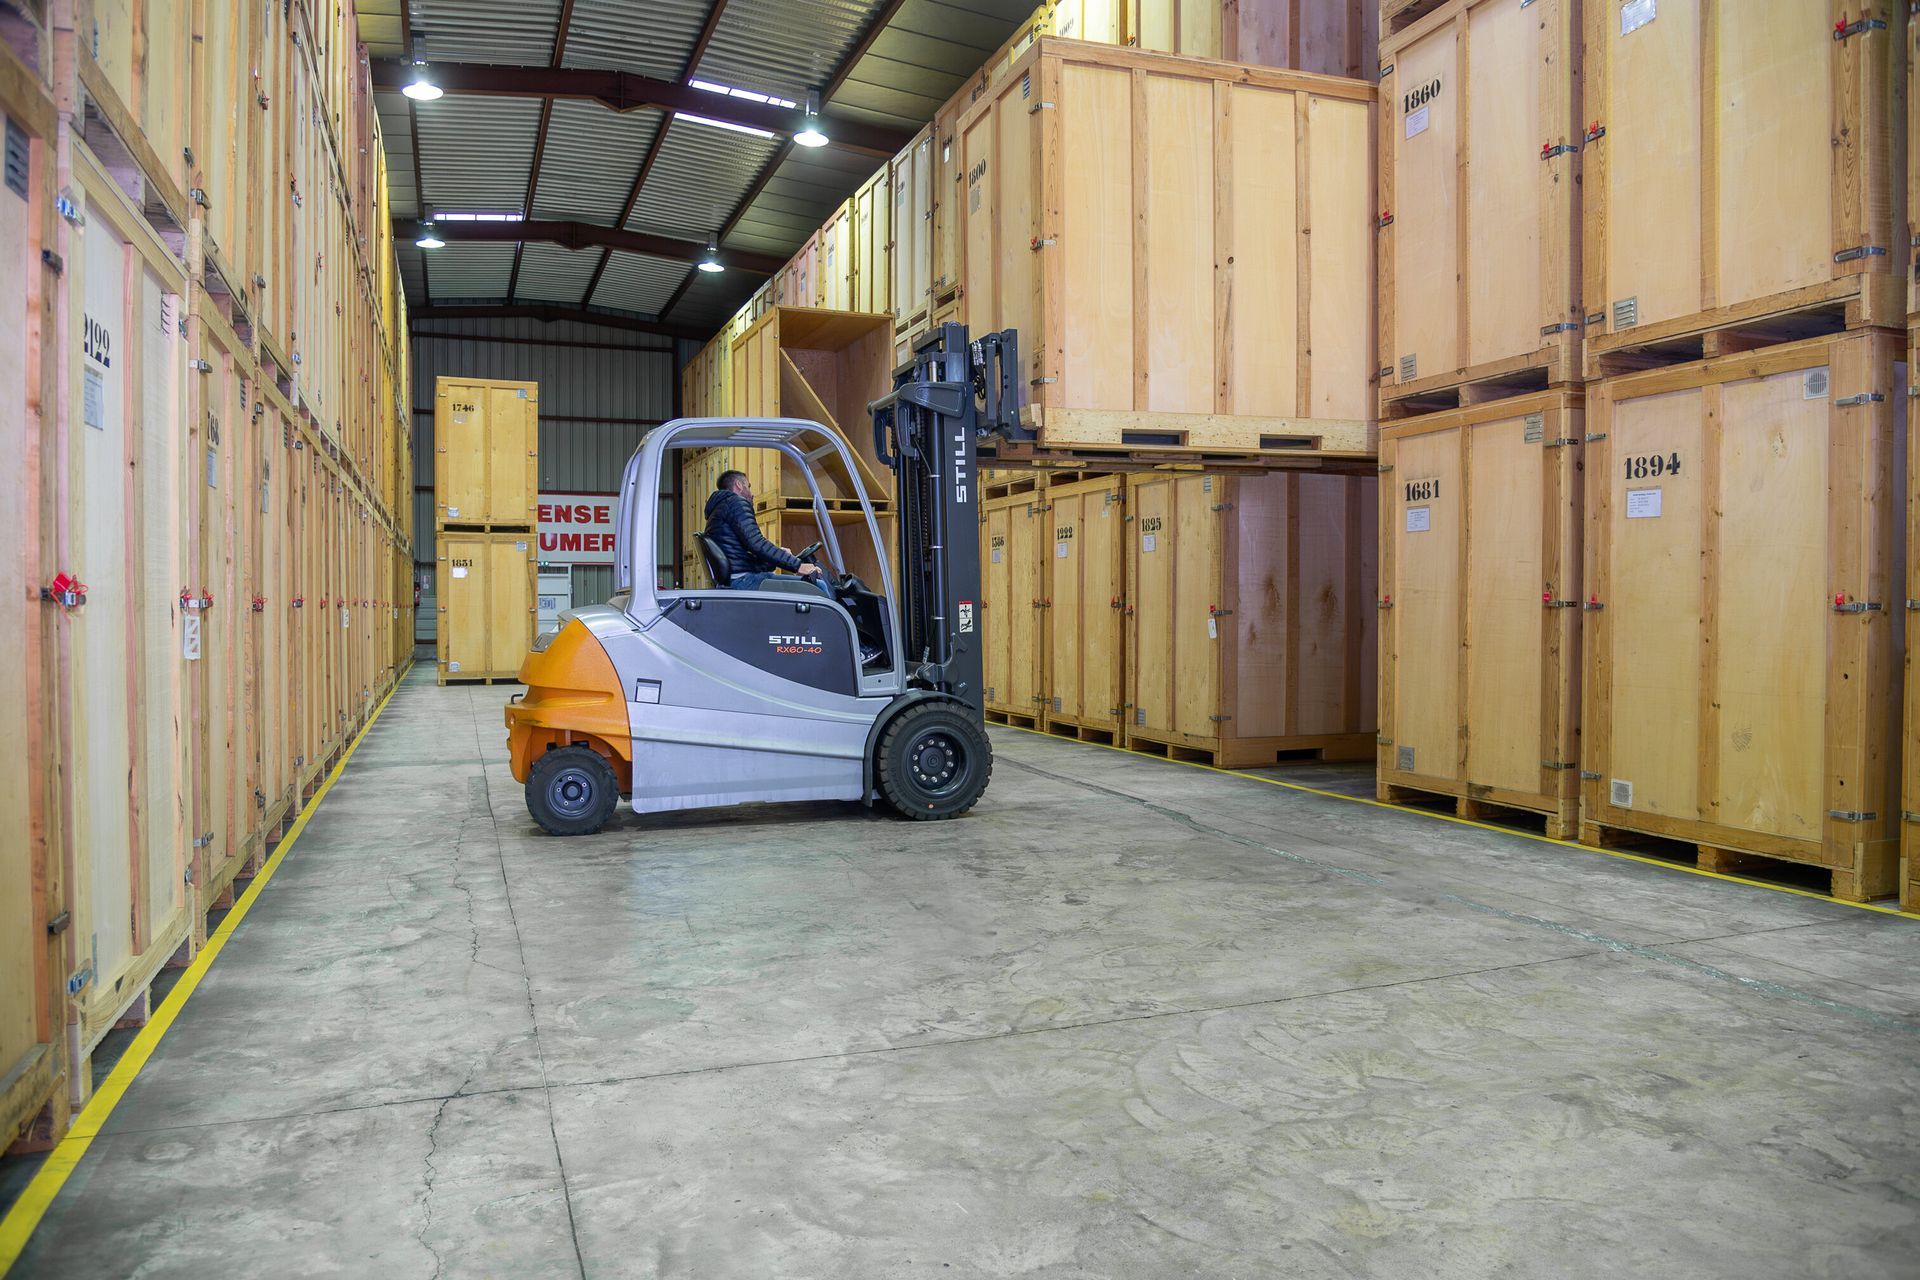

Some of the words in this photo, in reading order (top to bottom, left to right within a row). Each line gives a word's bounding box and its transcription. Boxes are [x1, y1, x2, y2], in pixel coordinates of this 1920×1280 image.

[1404, 79, 1441, 113] 1860
[968, 158, 987, 188] 1800
[452, 403, 475, 412] 1746
[955, 427, 967, 503] STILL
[1624, 452, 1681, 480] 1894
[1405, 479, 1440, 502] 1681
[537, 504, 611, 524] ENSE
[768, 635, 823, 645] STILL
[776, 646, 823, 654] RX60-40
